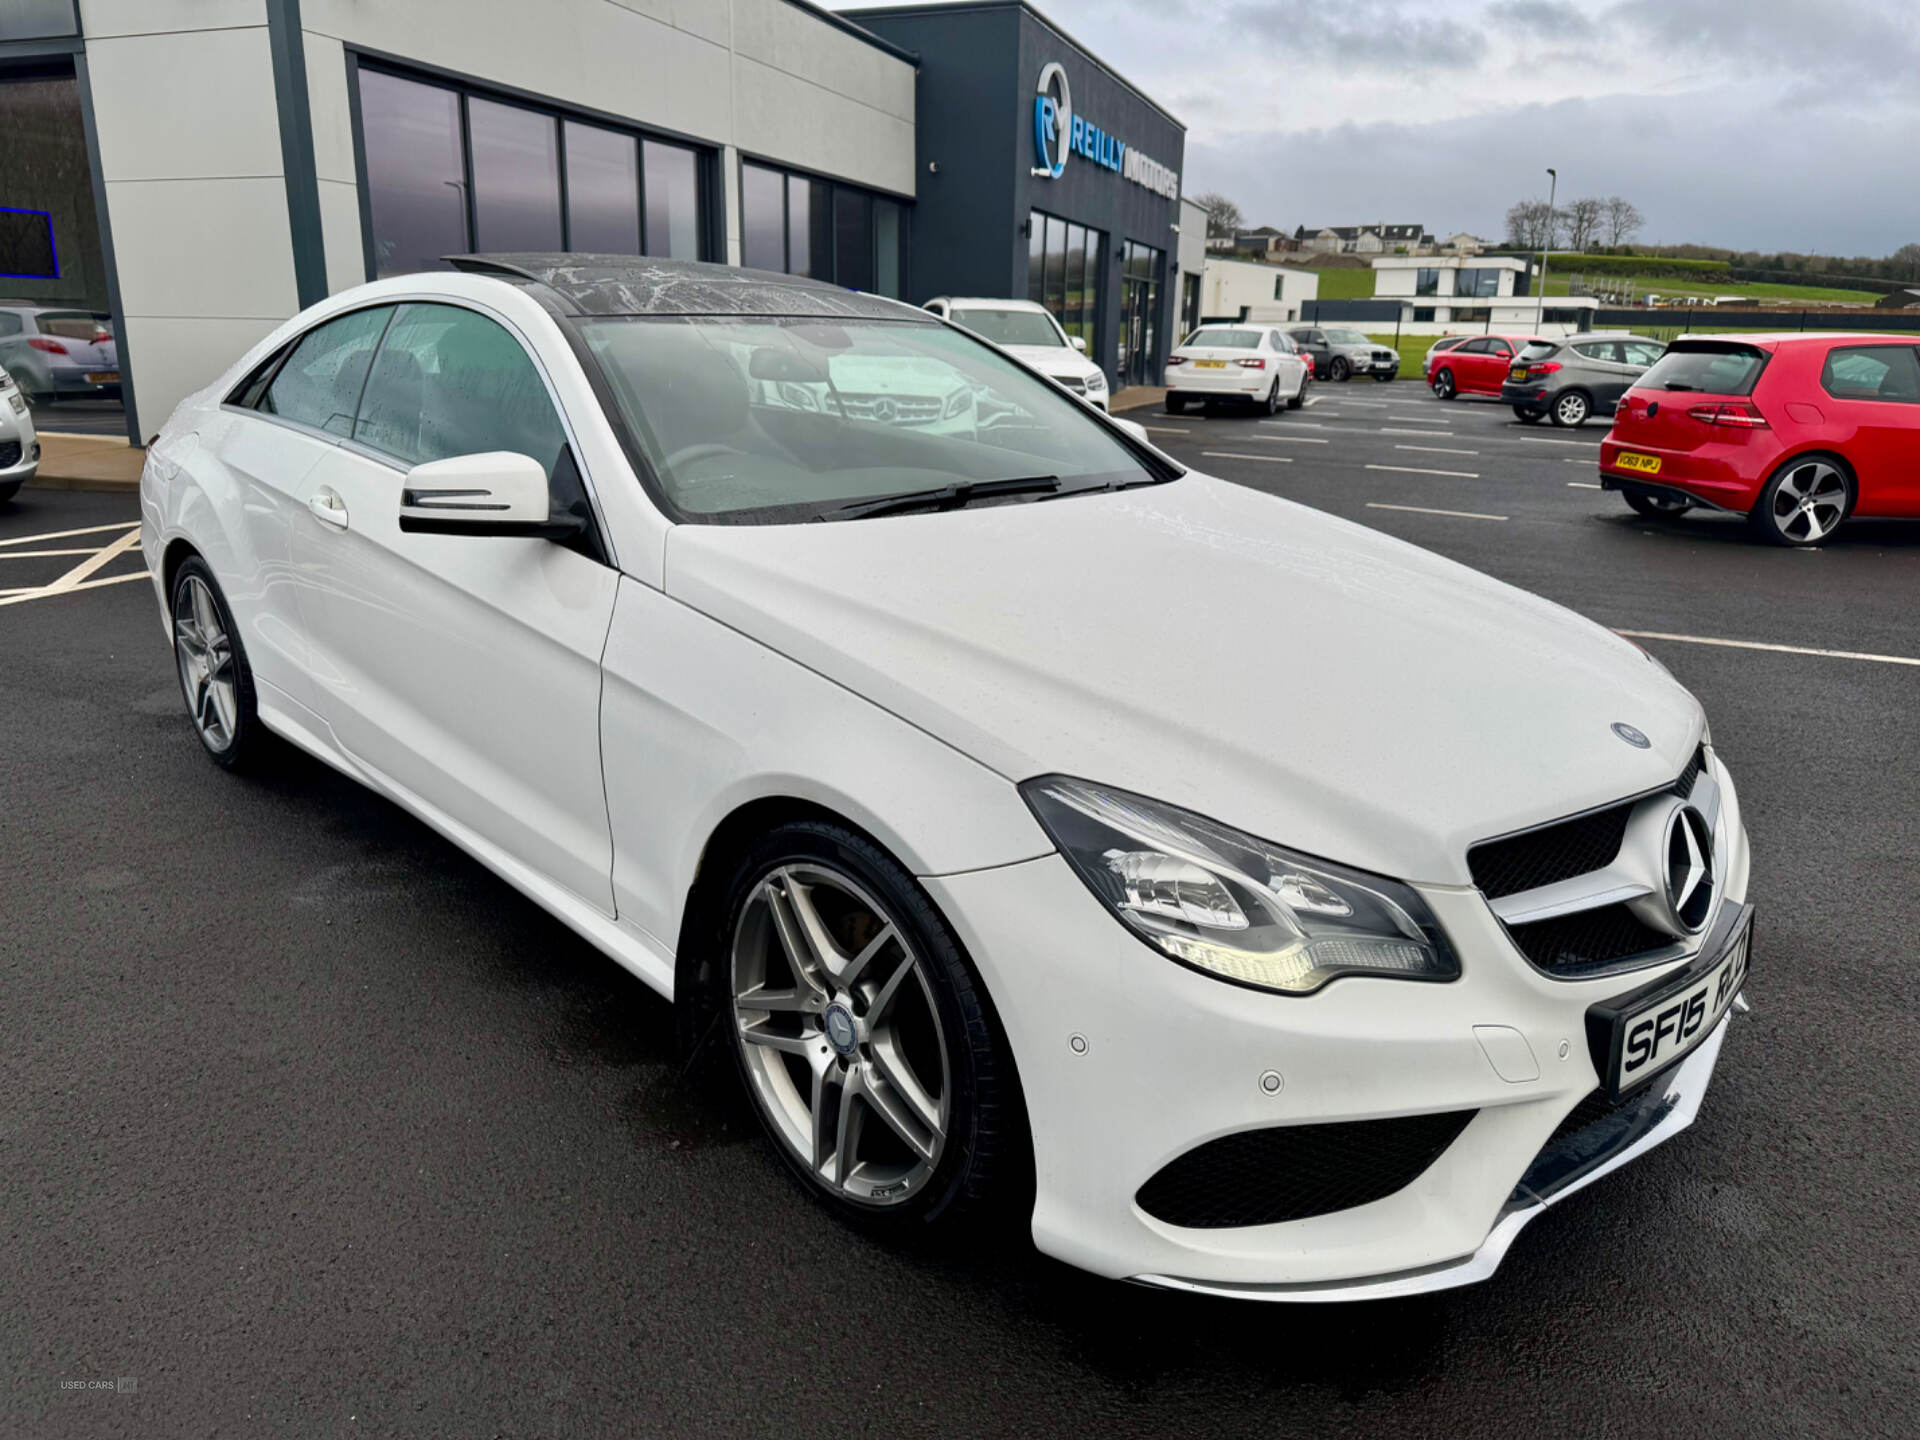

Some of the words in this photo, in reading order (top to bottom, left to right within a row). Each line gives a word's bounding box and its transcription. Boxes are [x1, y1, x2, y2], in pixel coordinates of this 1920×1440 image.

[1070, 114, 1125, 173] REILLY
[1124, 147, 1178, 200] MOTORS
[1625, 986, 1709, 1073] SF15
